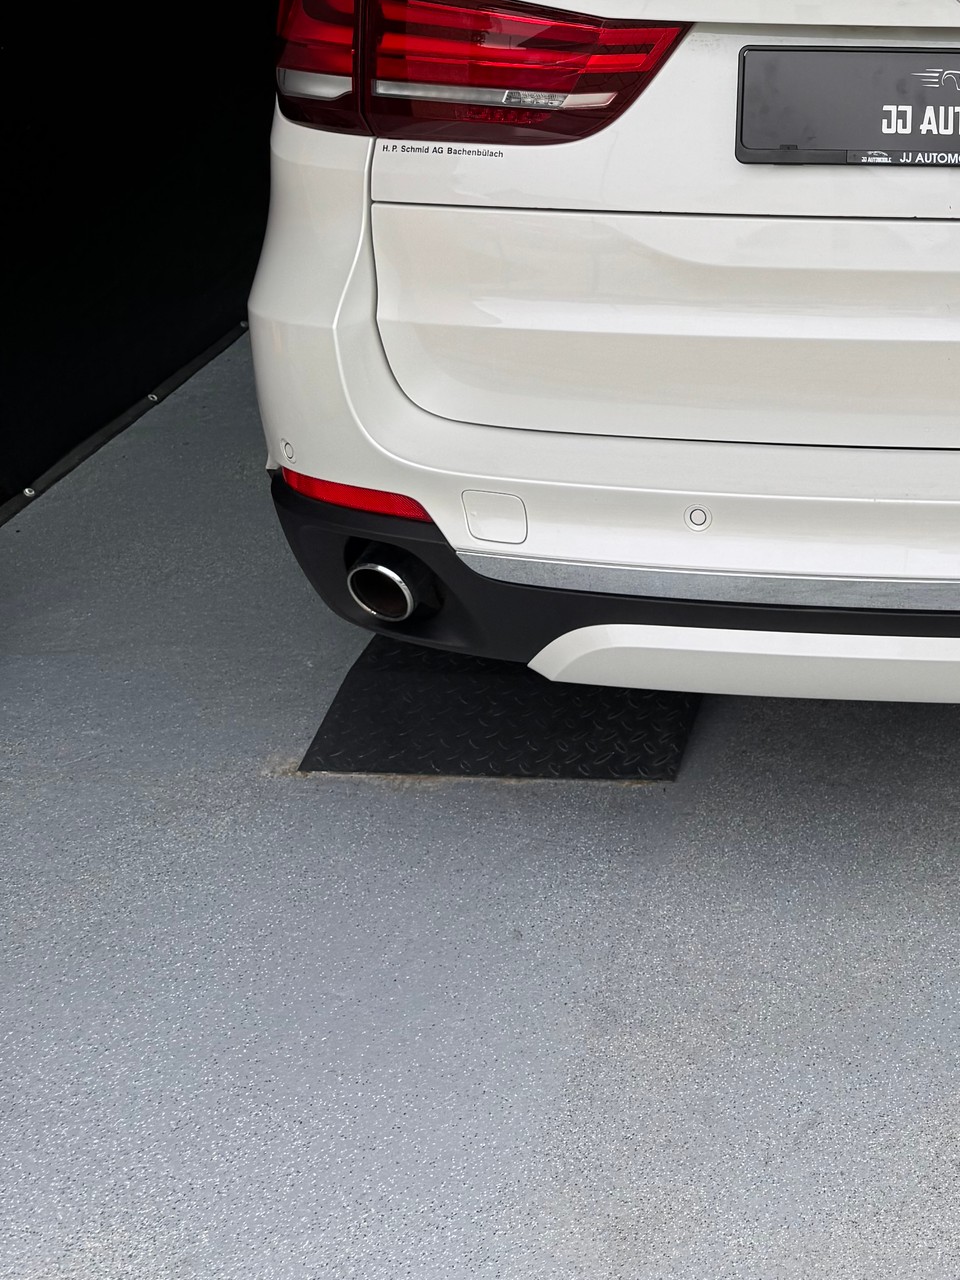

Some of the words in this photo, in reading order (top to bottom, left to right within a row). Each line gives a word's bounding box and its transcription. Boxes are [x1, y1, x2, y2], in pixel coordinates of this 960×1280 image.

[881, 104, 913, 135] JJ
[400, 145, 430, 154] Schmid
[431, 147, 444, 155] AG
[899, 152, 913, 163] JJ
